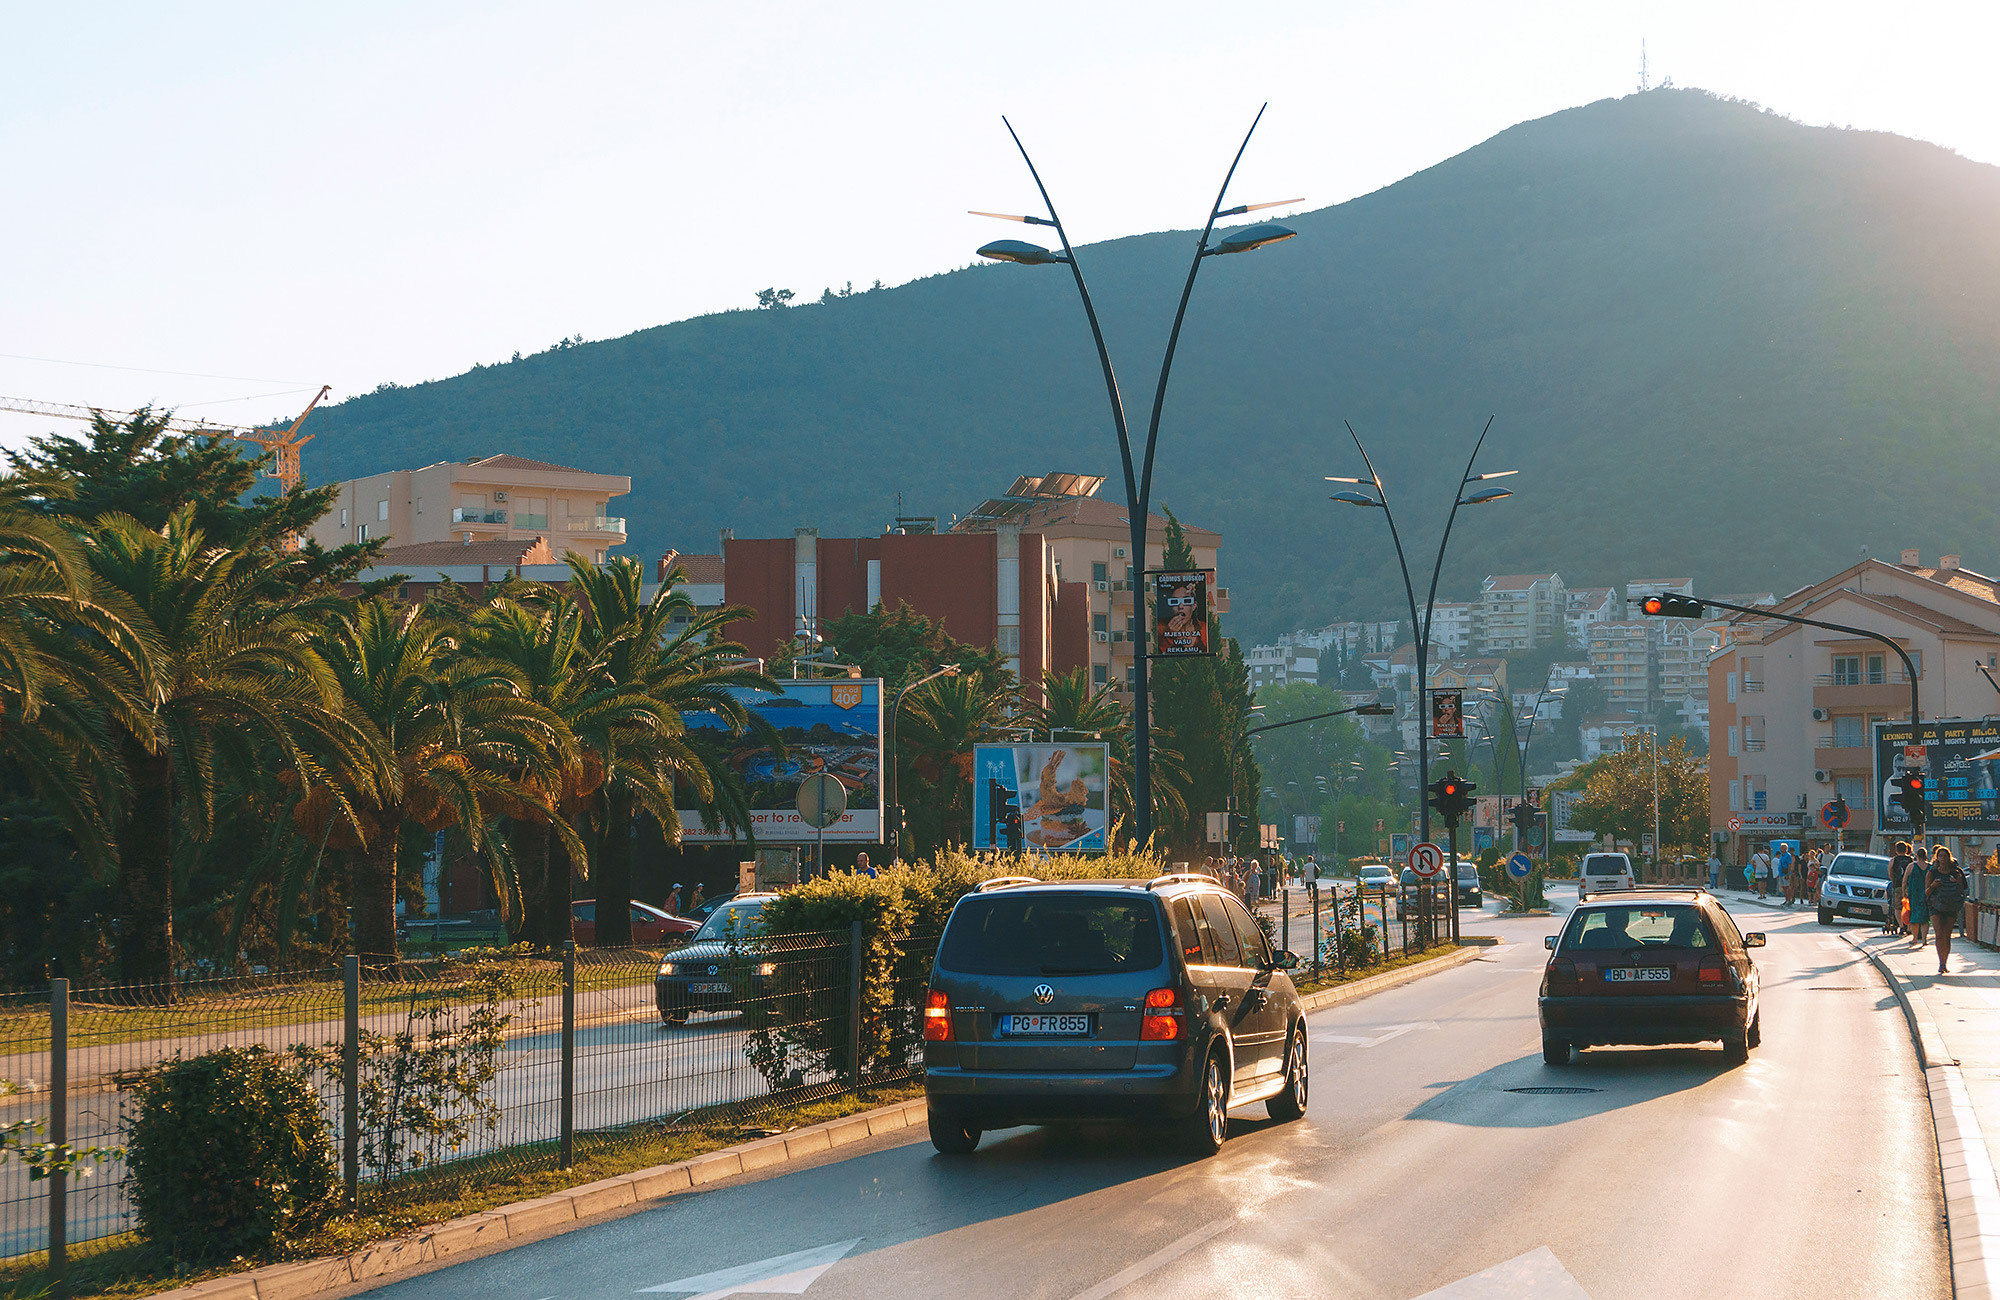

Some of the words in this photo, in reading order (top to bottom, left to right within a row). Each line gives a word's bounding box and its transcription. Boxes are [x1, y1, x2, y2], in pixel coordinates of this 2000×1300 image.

[835, 693, 858, 705] 40€
[1944, 730, 1966, 738] PARTY
[1932, 802, 1982, 820] DISCOTECA
[772, 812, 784, 823] to
[1761, 816, 1787, 824] FOOD
[1612, 969, 1627, 980] BD
[1012, 1016, 1030, 1031] PG
